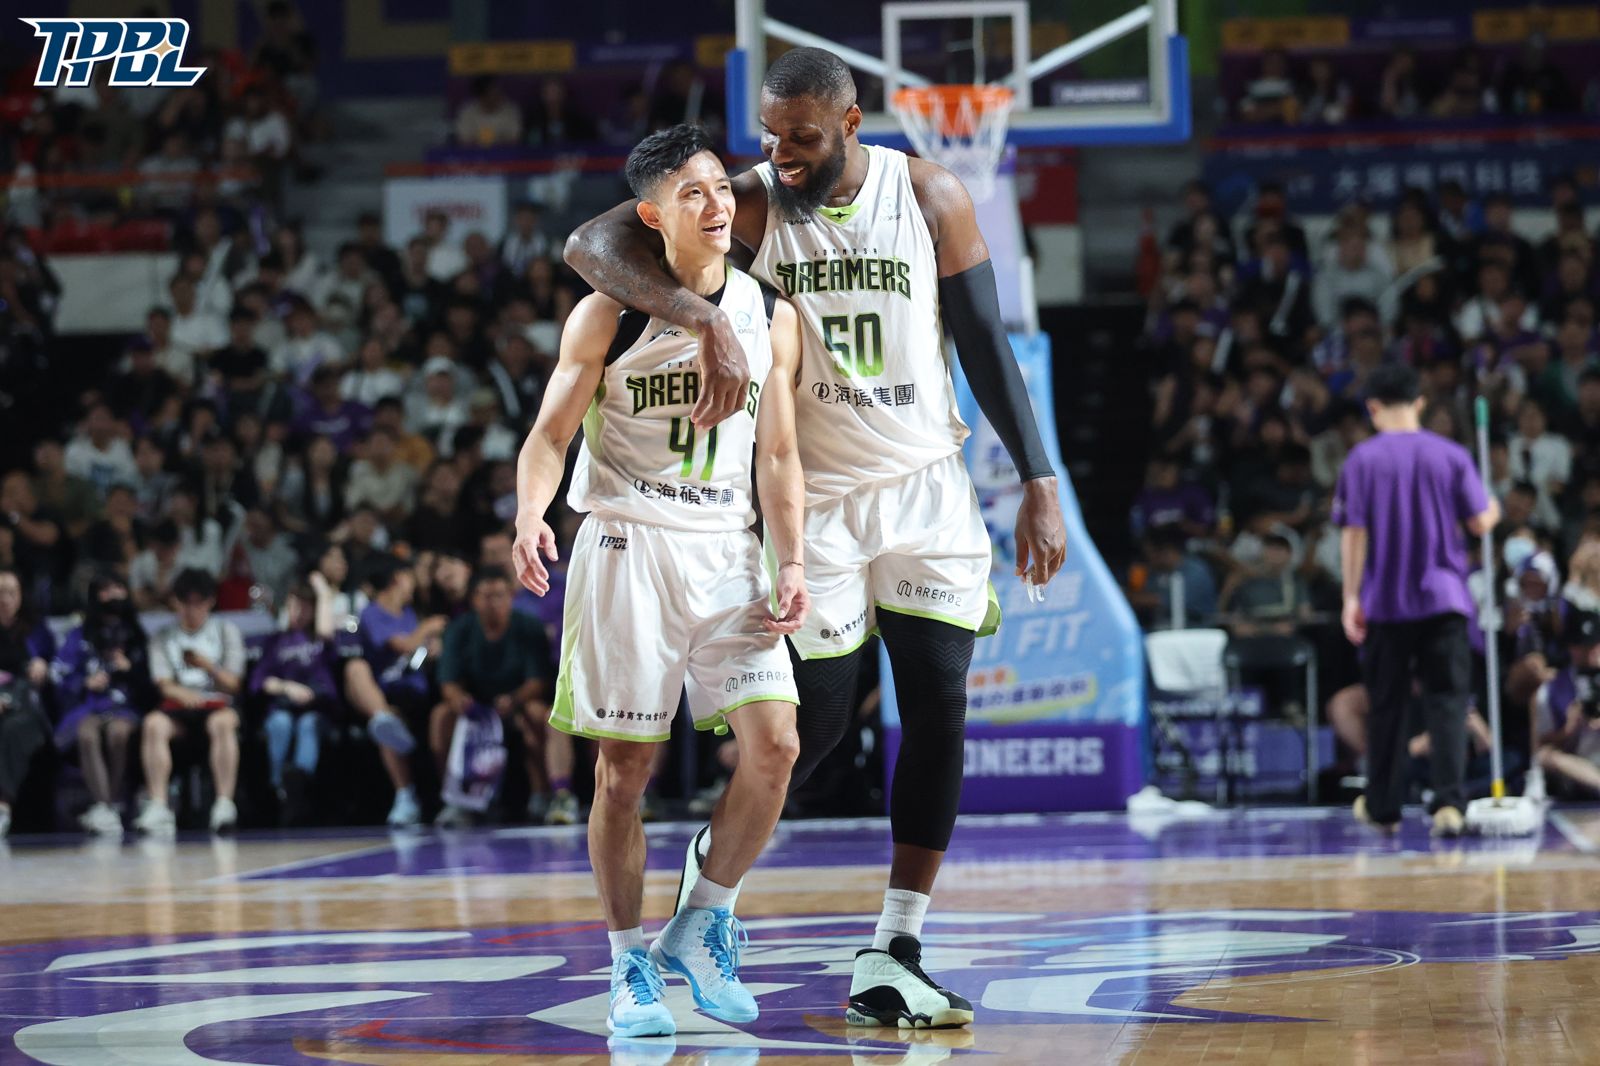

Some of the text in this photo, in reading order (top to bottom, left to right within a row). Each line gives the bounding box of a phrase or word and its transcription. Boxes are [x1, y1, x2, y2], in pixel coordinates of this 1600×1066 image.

[814, 247, 878, 256] FORMOSA
[775, 257, 912, 301] DREAMERS
[821, 312, 885, 378] 50
[625, 371, 760, 419] DREAS
[834, 383, 915, 408] 海碩集團
[656, 482, 736, 508] 海碩集團
[599, 535, 628, 550] TPBL
[914, 586, 962, 607] AREA02
[1016, 610, 1091, 656] FIT
[740, 671, 788, 684] AREA02
